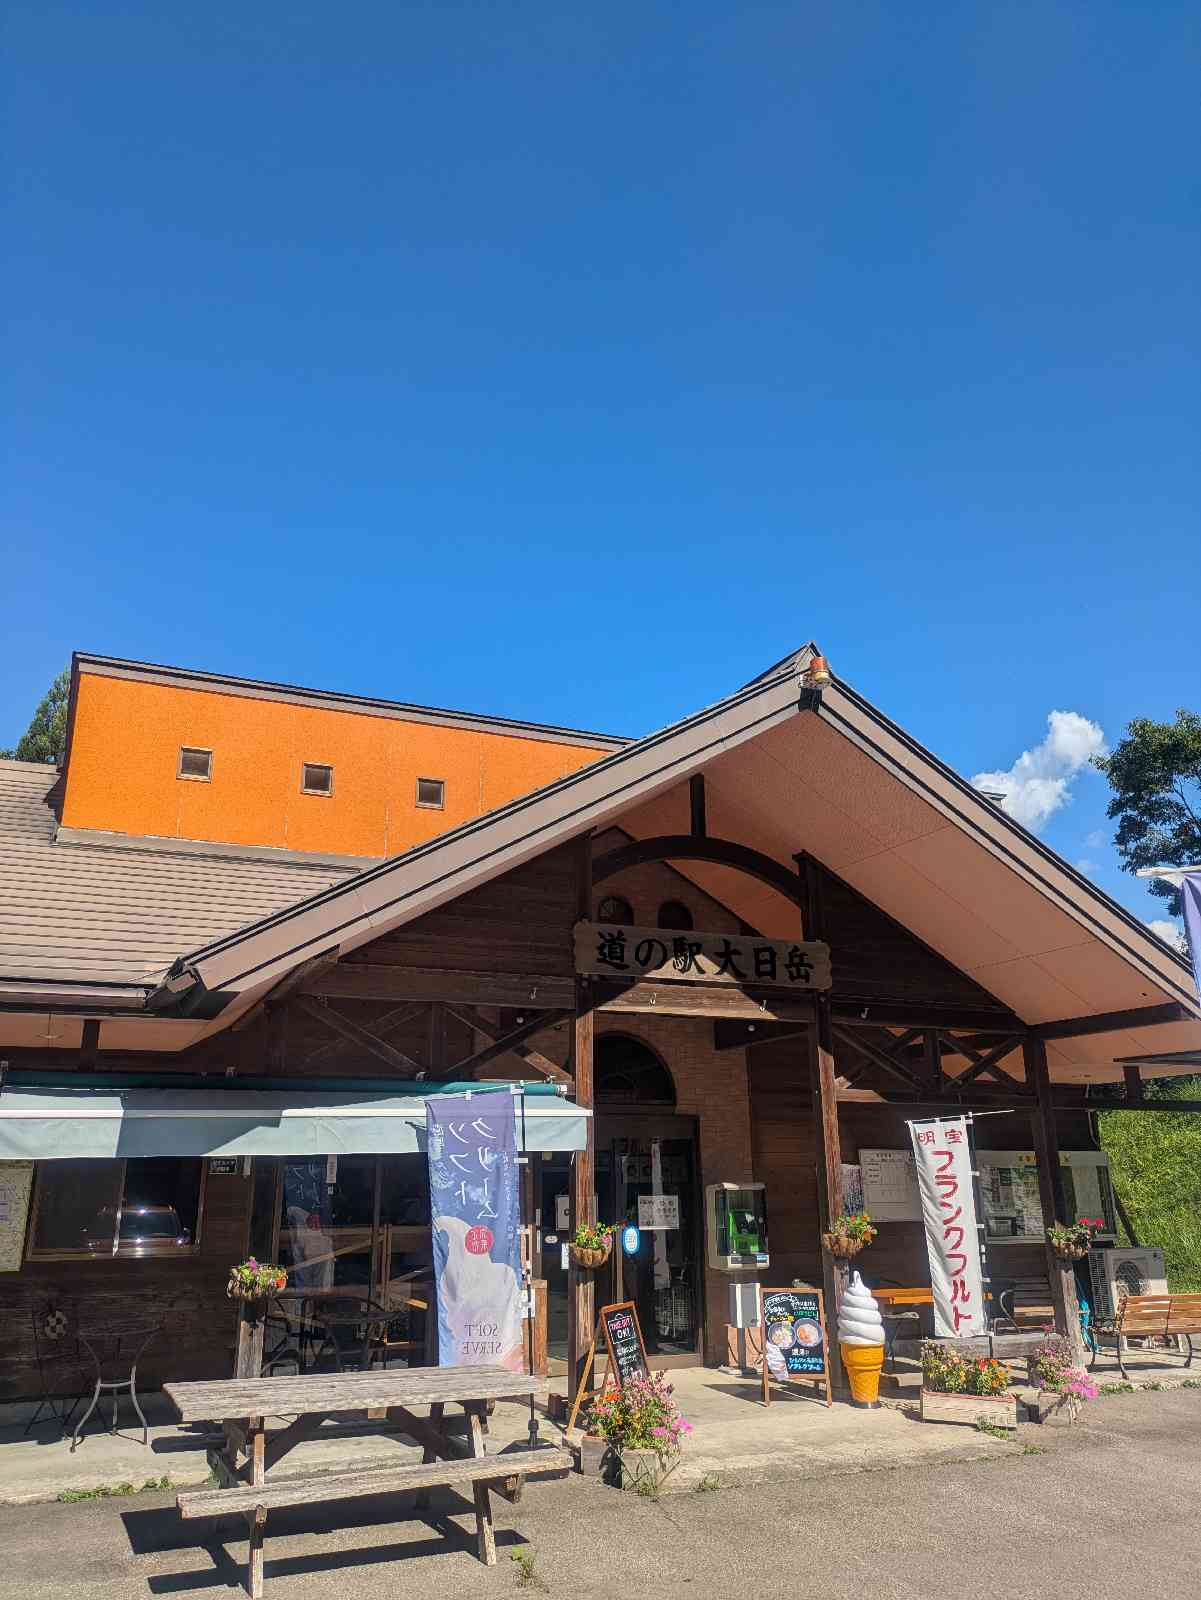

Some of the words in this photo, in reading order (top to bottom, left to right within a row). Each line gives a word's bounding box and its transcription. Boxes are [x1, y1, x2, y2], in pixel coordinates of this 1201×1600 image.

[597, 930, 814, 984] 道の駅大日岳
[931, 1150, 973, 1333] フランクフルト
